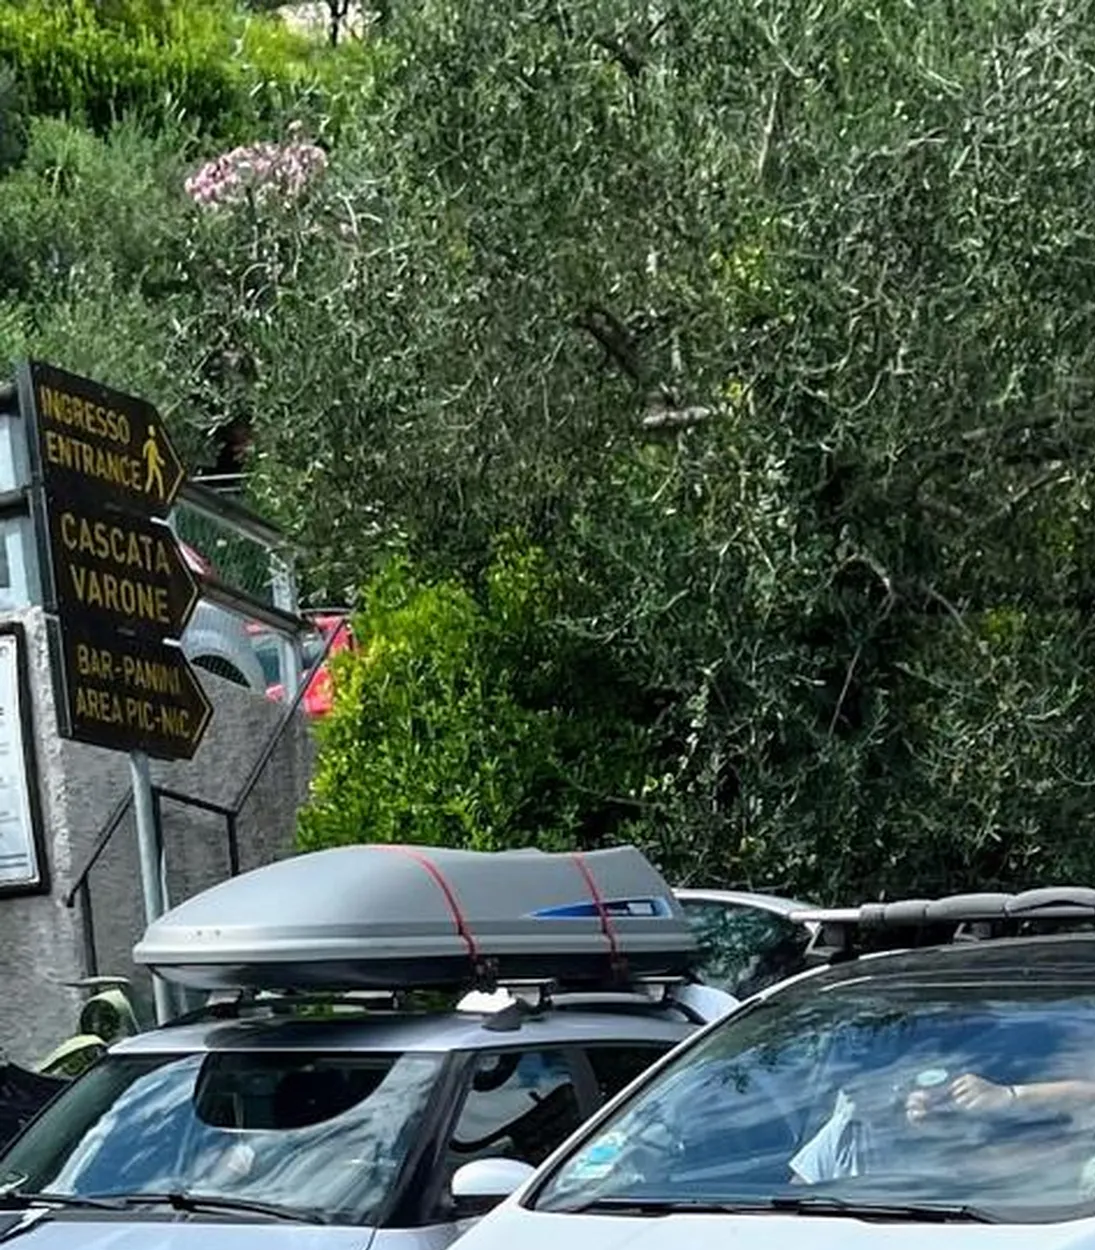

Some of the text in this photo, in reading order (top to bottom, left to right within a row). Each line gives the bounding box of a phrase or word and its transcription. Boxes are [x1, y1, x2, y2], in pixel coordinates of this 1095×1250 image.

[40, 385, 131, 446] INGRESSO
[45, 430, 142, 492] ENTRANCE
[61, 511, 171, 575] CASCATA
[70, 563, 171, 624] VARONE
[77, 643, 182, 695] BAR-PANINI
[75, 687, 191, 739] AREA PIC-NIC
